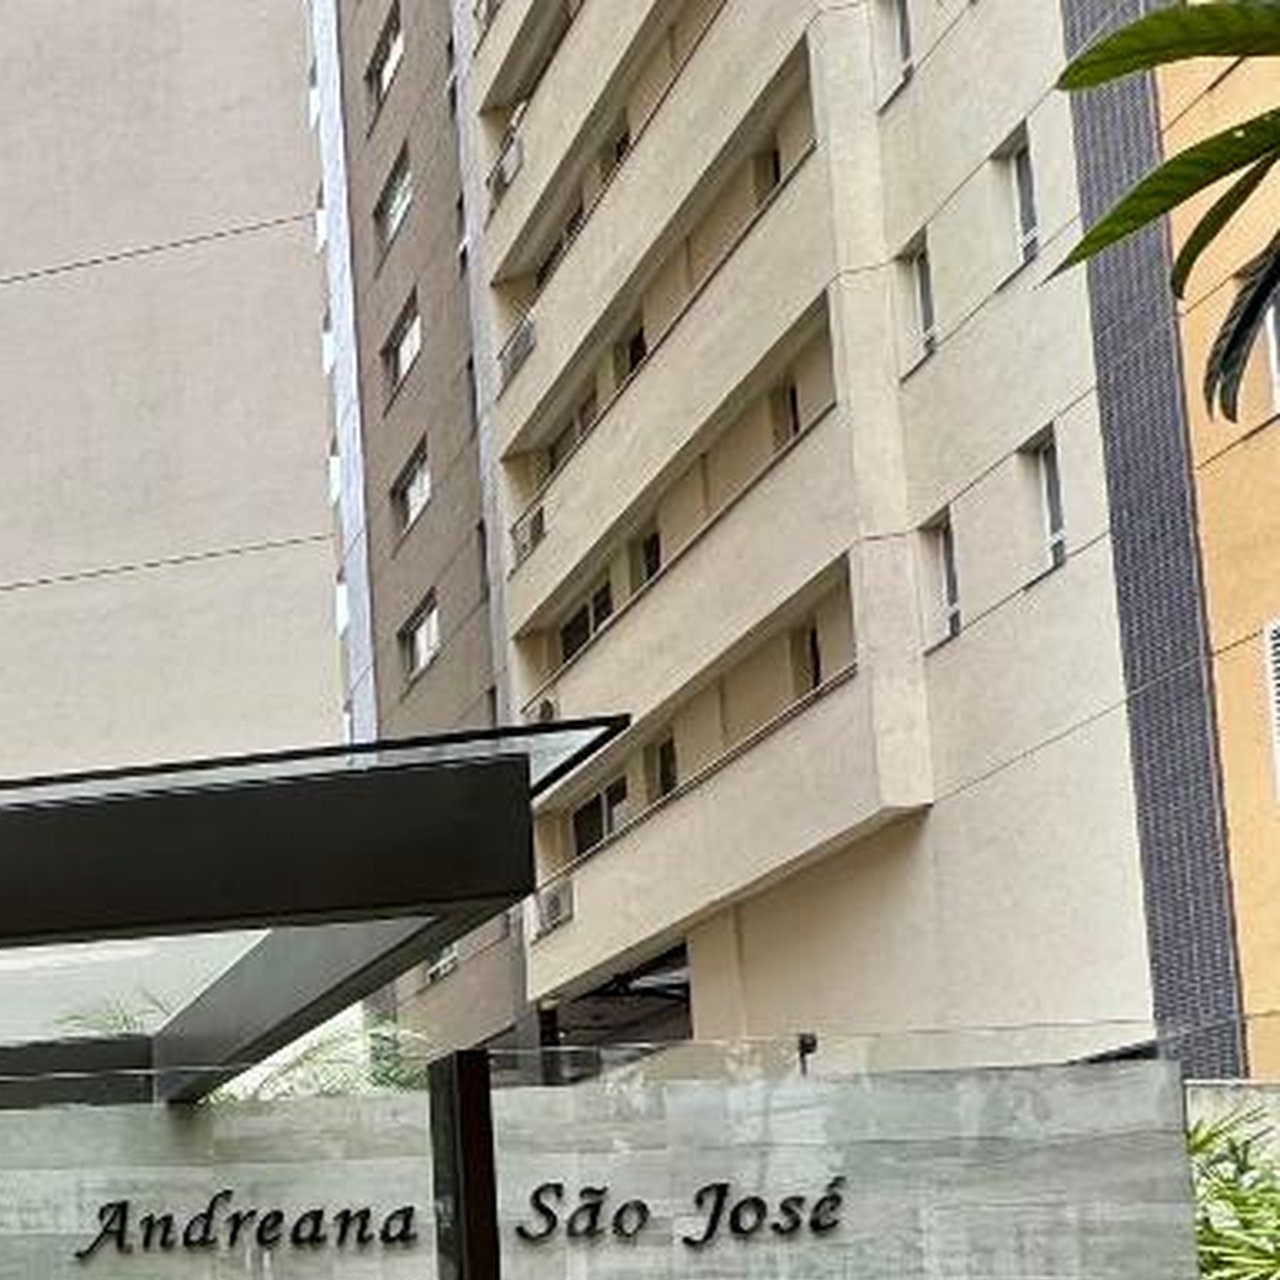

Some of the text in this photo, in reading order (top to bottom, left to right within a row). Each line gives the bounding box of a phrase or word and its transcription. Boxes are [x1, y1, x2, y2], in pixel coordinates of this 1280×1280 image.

[74, 1175, 847, 1261] Andreana São José
